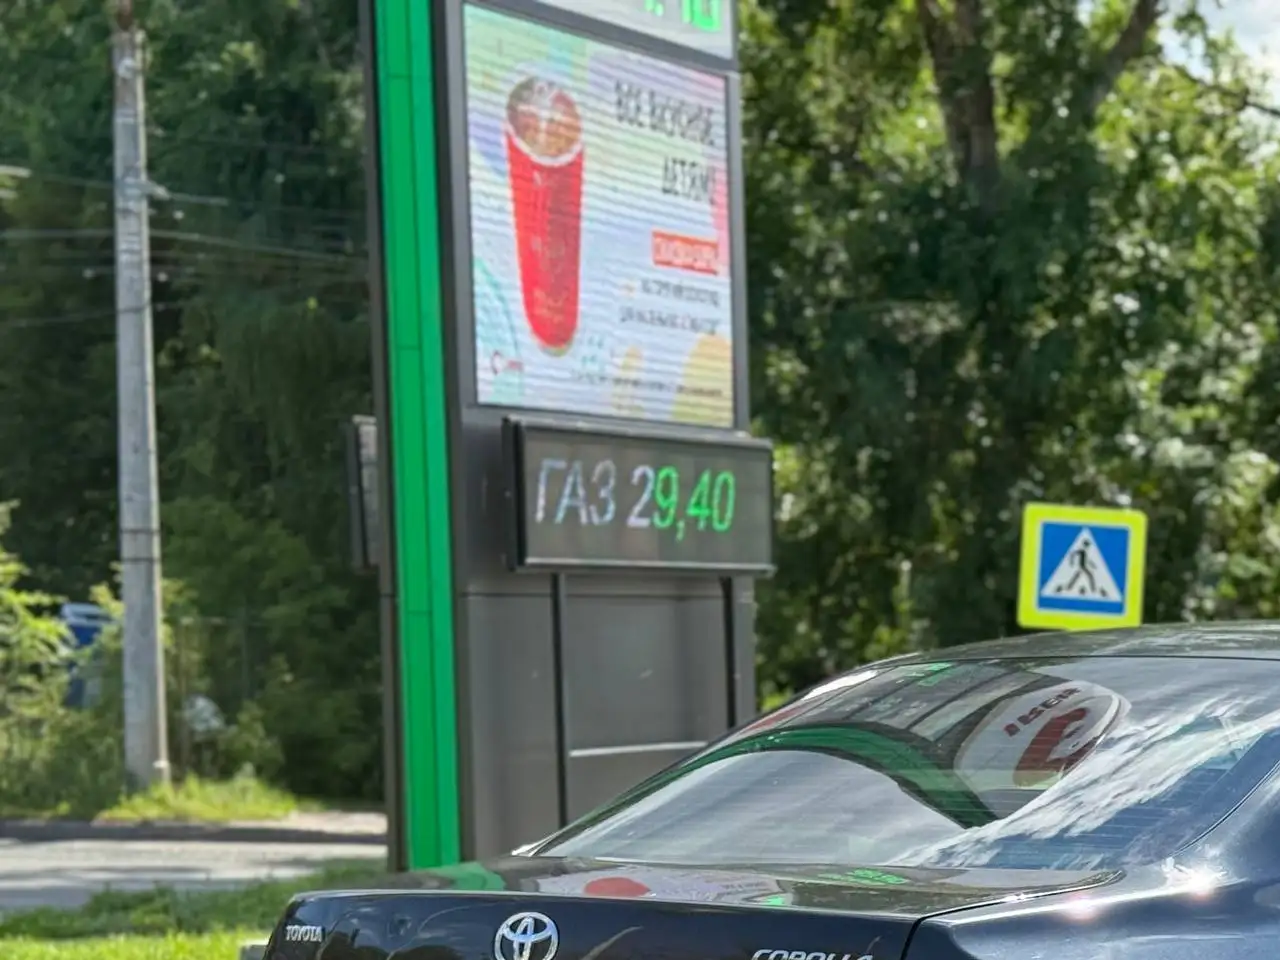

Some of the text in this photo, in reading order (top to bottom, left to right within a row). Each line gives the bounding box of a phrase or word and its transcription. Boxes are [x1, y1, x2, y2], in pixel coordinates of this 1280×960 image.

[534, 457, 737, 542] ГАЗ 29,40
[285, 924, 323, 942] TOYOTA
